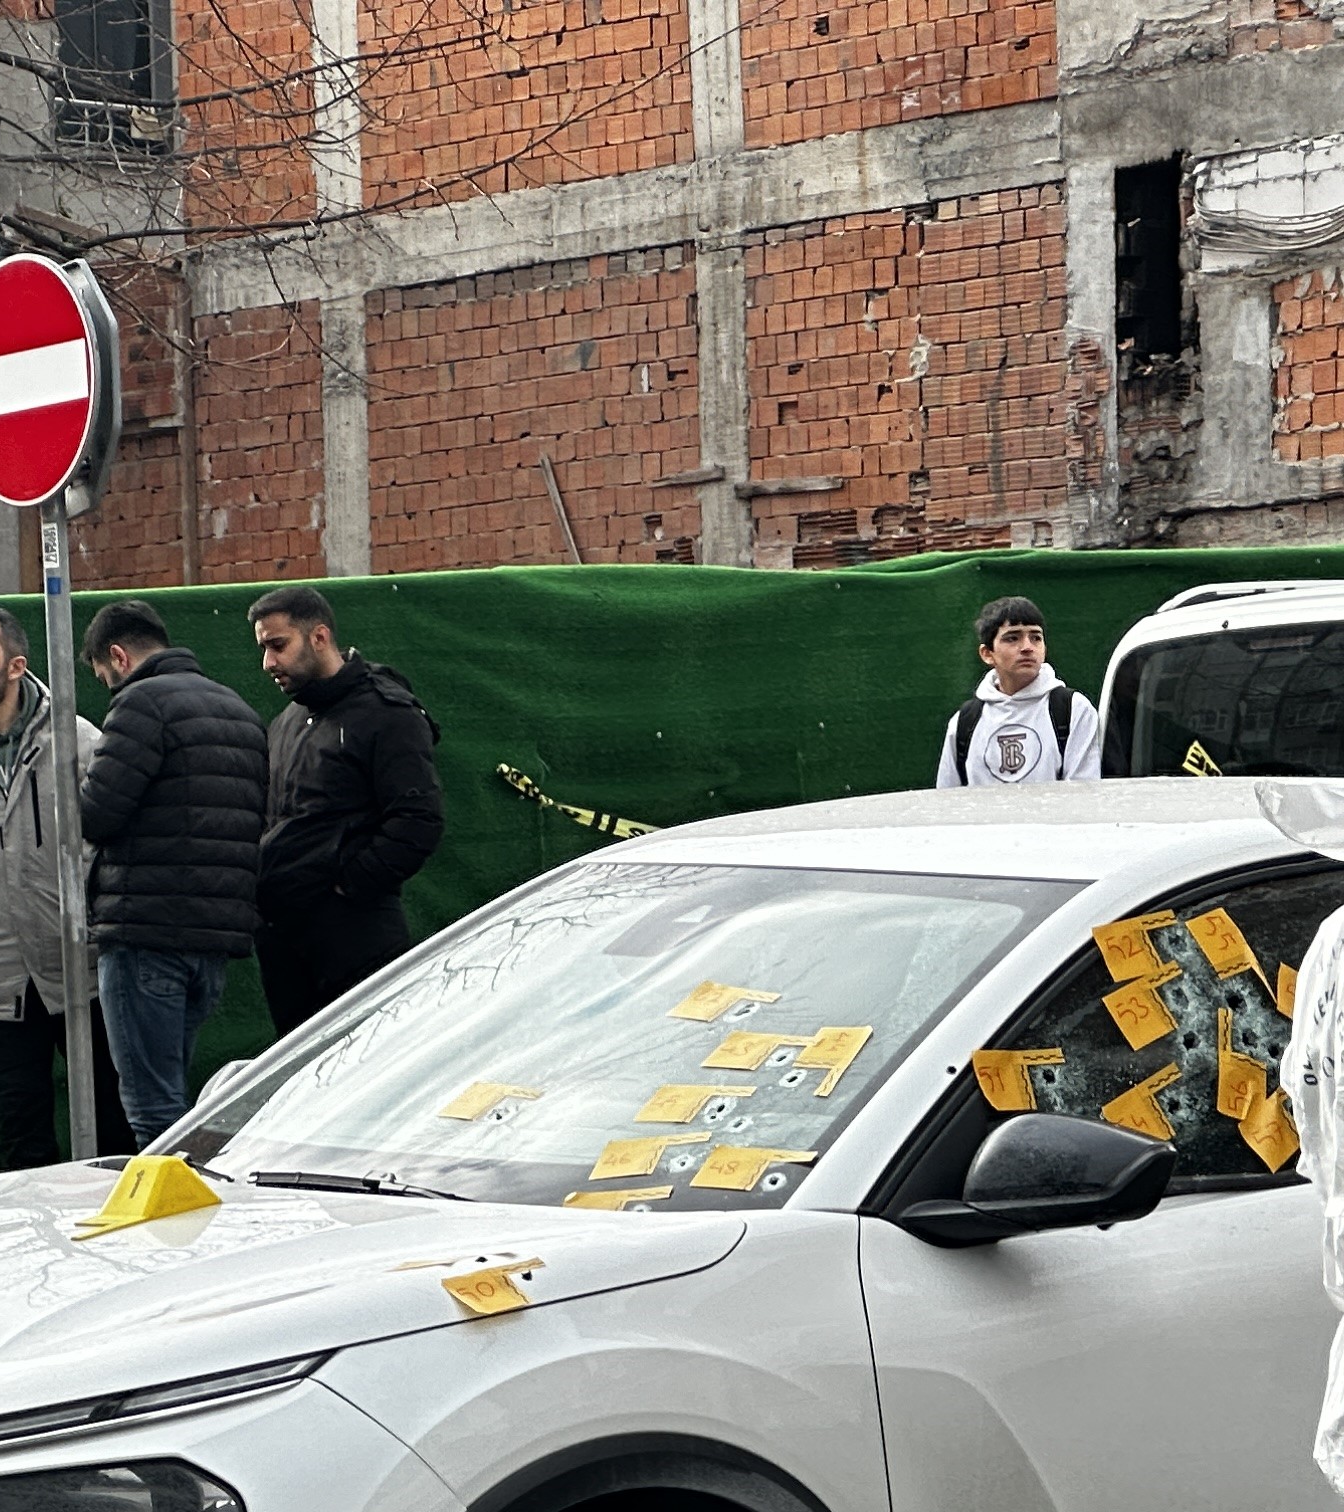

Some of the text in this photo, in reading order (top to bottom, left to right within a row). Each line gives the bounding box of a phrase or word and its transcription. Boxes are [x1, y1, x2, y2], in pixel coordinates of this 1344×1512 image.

[1106, 933, 1145, 961] 52
[1205, 915, 1237, 951] 55
[1118, 995, 1149, 1026] 53
[978, 1065, 1006, 1093] 51
[603, 1152, 631, 1167] 46
[709, 1160, 740, 1176] 48
[129, 1169, 145, 1199] 1
[456, 1281, 495, 1302] 50
